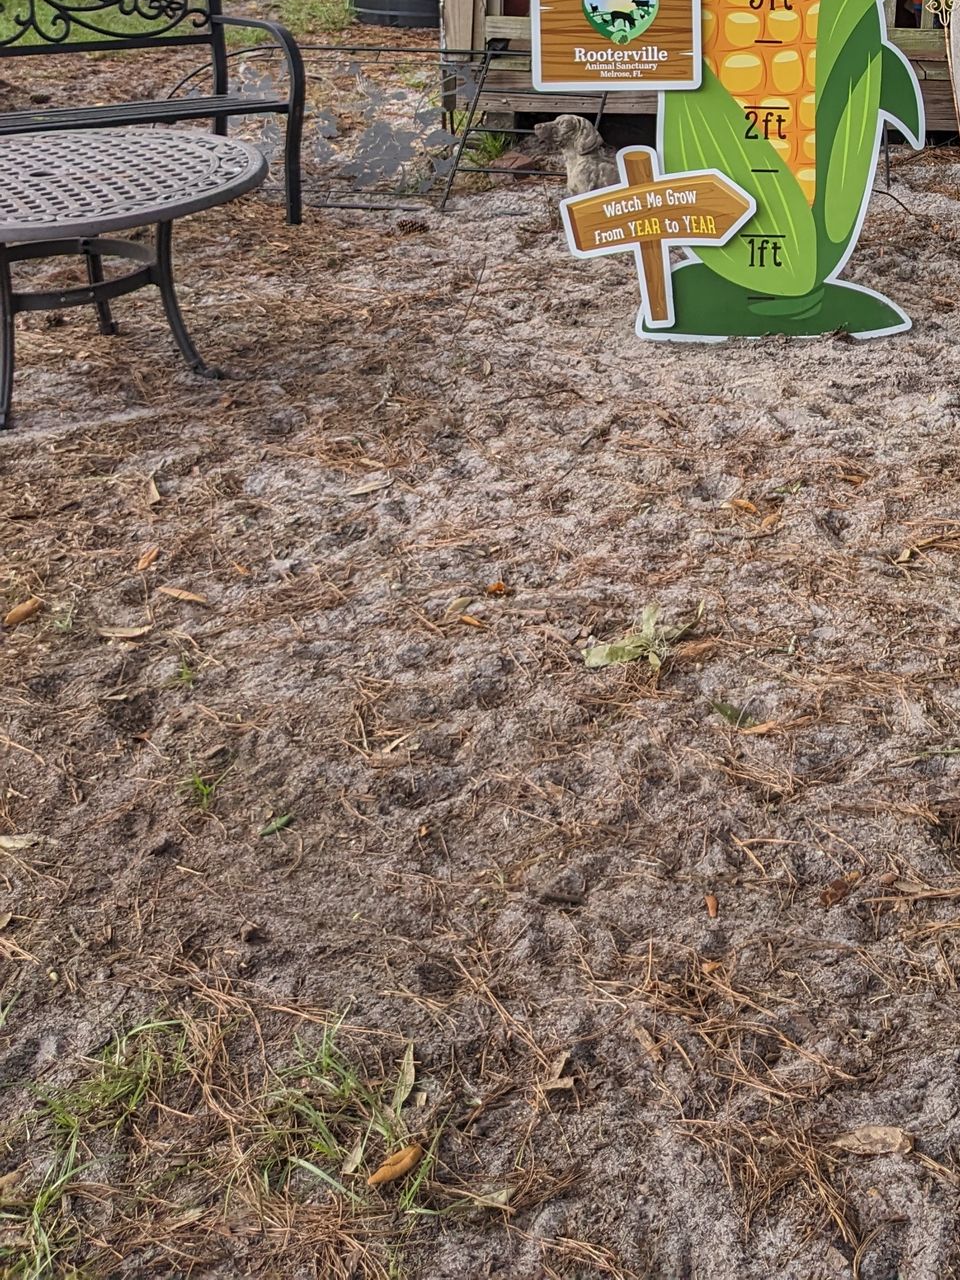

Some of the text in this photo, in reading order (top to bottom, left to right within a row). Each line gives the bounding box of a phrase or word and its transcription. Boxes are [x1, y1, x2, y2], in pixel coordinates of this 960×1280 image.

[574, 46, 668, 62] Rooterville
[585, 62, 658, 71] Animal Sanctuary
[600, 70, 632, 78] Melrose,
[744, 111, 787, 140] 2ft
[603, 189, 697, 218] Watch Me Grow
[594, 215, 717, 245] From YEAR to YEAR
[748, 238, 782, 267] 1ft
